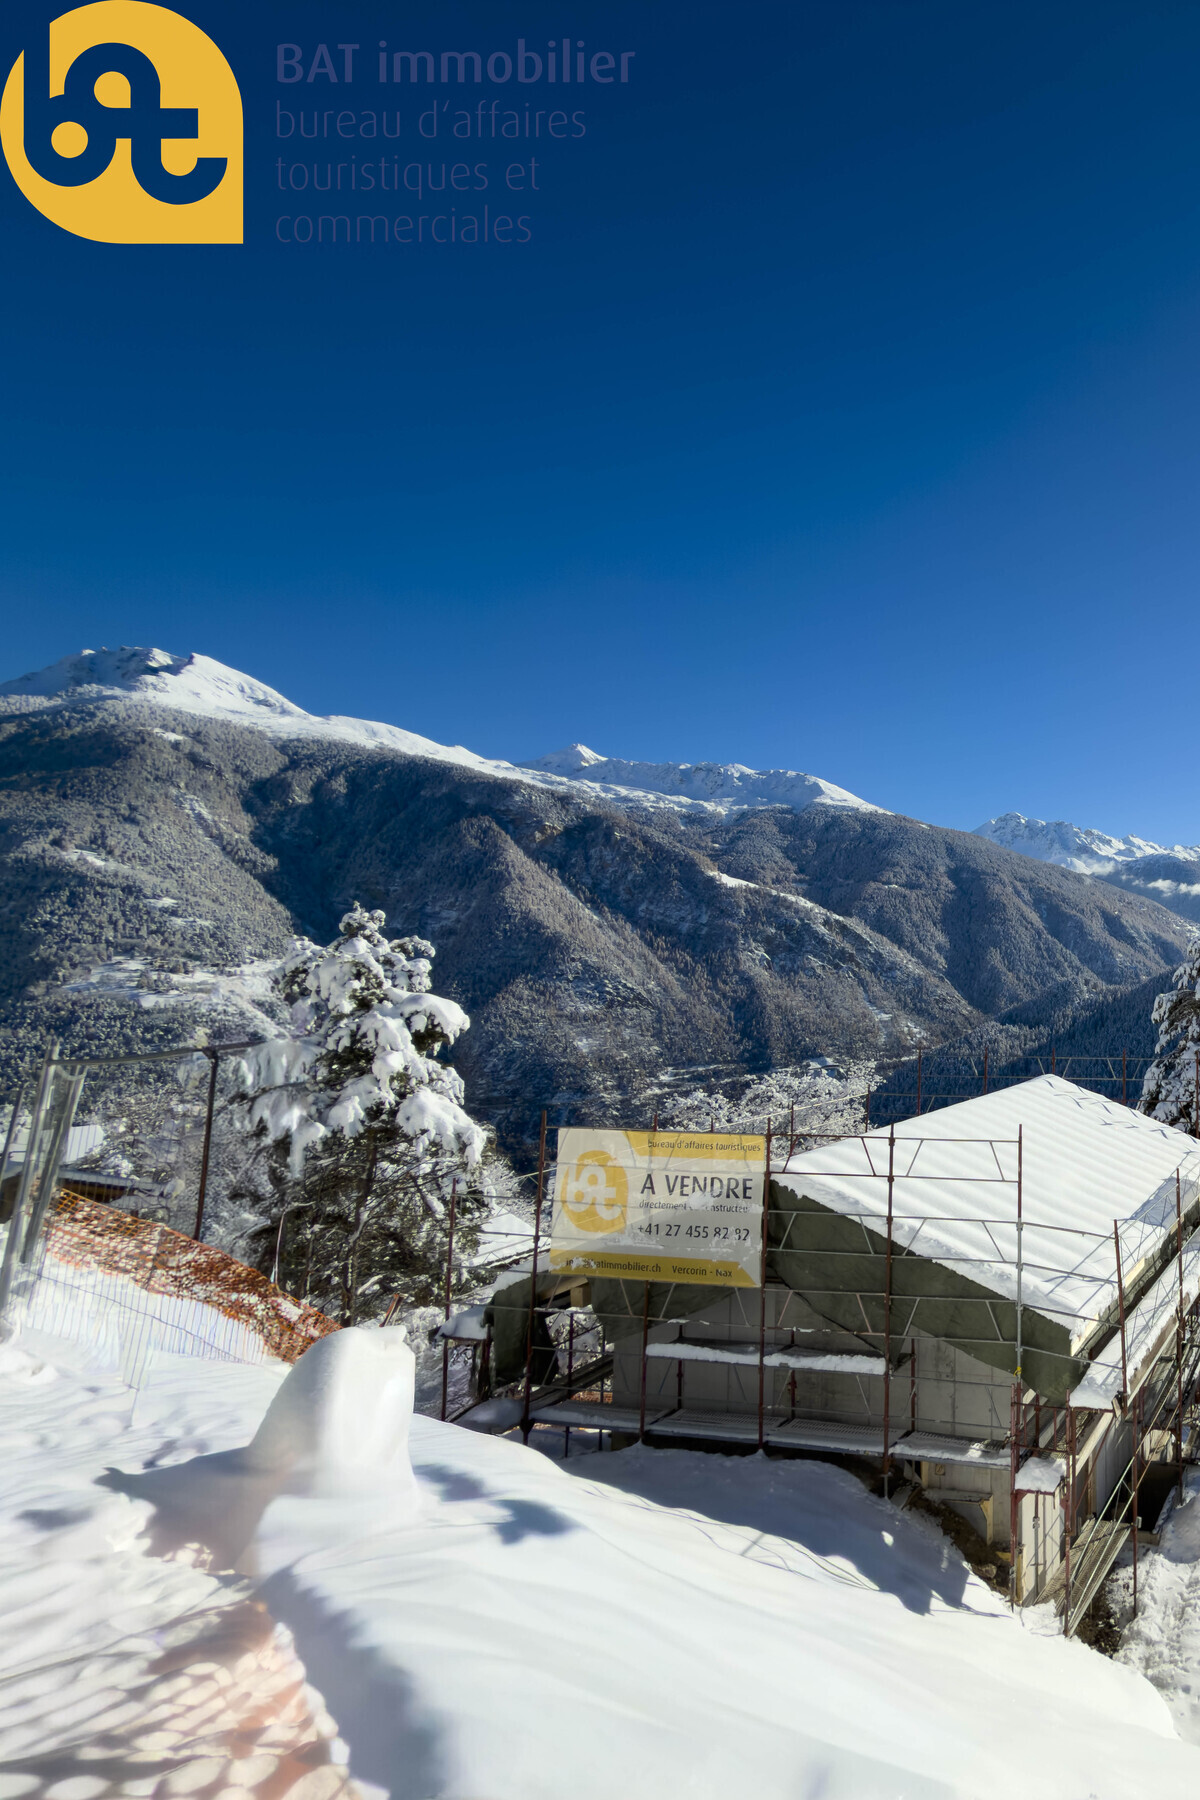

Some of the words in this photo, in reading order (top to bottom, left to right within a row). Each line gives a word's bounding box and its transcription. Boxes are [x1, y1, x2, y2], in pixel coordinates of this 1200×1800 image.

[648, 1138, 675, 1149] bureau
[676, 1140, 714, 1150] d'affaires
[716, 1142, 760, 1152] touristiques
[665, 1174, 753, 1199] VENDRE
[638, 1223, 660, 1236] +41
[665, 1224, 681, 1237] 27
[685, 1225, 709, 1239] 455
[714, 1226, 729, 1240] 82
[735, 1227, 750, 1241] 82
[672, 1265, 707, 1276] Vercorin
[715, 1268, 732, 1278] Nax
